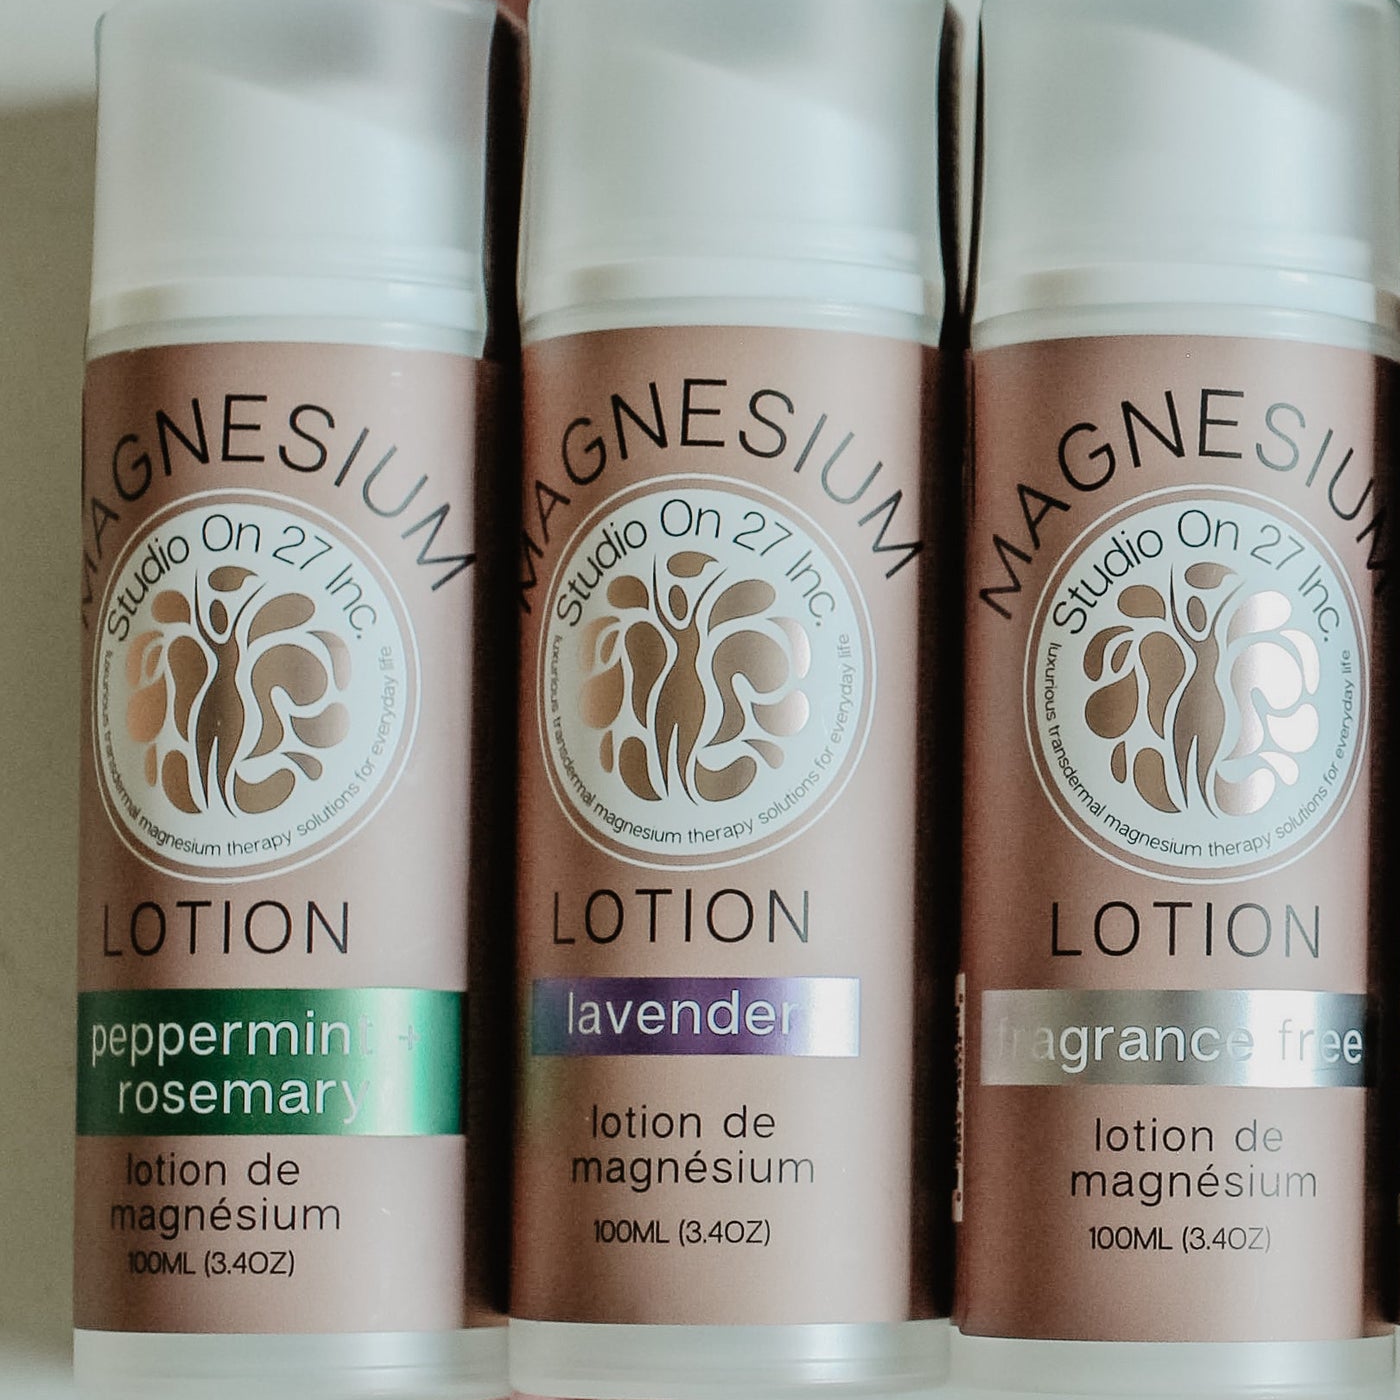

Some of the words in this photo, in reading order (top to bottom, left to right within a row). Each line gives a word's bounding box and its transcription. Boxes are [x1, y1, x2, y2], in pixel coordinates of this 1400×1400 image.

[106, 534, 190, 643] Studio
[202, 514, 260, 553] On
[272, 525, 333, 570] 27
[325, 563, 377, 640] Inc.
[556, 519, 648, 627] Studio
[660, 499, 722, 538] On
[732, 511, 793, 557] 27
[785, 550, 836, 627] Inc.
[1053, 529, 1164, 635] Studio
[1177, 510, 1240, 550] On
[1250, 524, 1305, 571] 27
[1298, 565, 1341, 643] Inc.
[379, 645, 393, 671] life
[838, 633, 851, 660] life
[1340, 649, 1351, 673] life
[1043, 640, 1062, 721] luxurious
[372, 676, 398, 756] everyday
[831, 664, 857, 745] everyday
[1336, 678, 1356, 761] everyday
[105, 730, 139, 819] transdermal
[355, 756, 377, 782] for
[551, 716, 594, 806] transdermal
[816, 744, 837, 768] for
[1048, 726, 1105, 817] transdermal
[1325, 763, 1340, 786] for
[296, 782, 360, 837] solutions
[757, 768, 820, 824] solutions
[1275, 786, 1328, 840] solutions
[139, 813, 222, 857] magnesium
[226, 829, 293, 857] therapy
[593, 801, 682, 844] magnesium
[687, 817, 754, 844] therapy
[1102, 813, 1202, 857] magnesium
[1208, 834, 1272, 858] therapy
[103, 900, 349, 957] LOTION
[552, 888, 809, 944] LOTION
[1052, 901, 1319, 958] LOTION
[567, 989, 800, 1036] lavender
[91, 1011, 373, 1067] peppermint
[1277, 1019, 1363, 1064] free
[118, 1077, 369, 1124] rosemary
[592, 1105, 702, 1138] lotion
[723, 1105, 776, 1138] de
[1095, 1117, 1213, 1152] lotion
[1235, 1119, 1283, 1152] de
[126, 1152, 226, 1186] lotion
[247, 1152, 300, 1186] de
[571, 1150, 814, 1192] magnésium
[1070, 1164, 1316, 1206] magnésium
[111, 1197, 341, 1239] magnésium
[593, 1219, 669, 1244] 100ML
[1089, 1226, 1172, 1251] 100ML
[128, 1251, 195, 1275] 100ML
